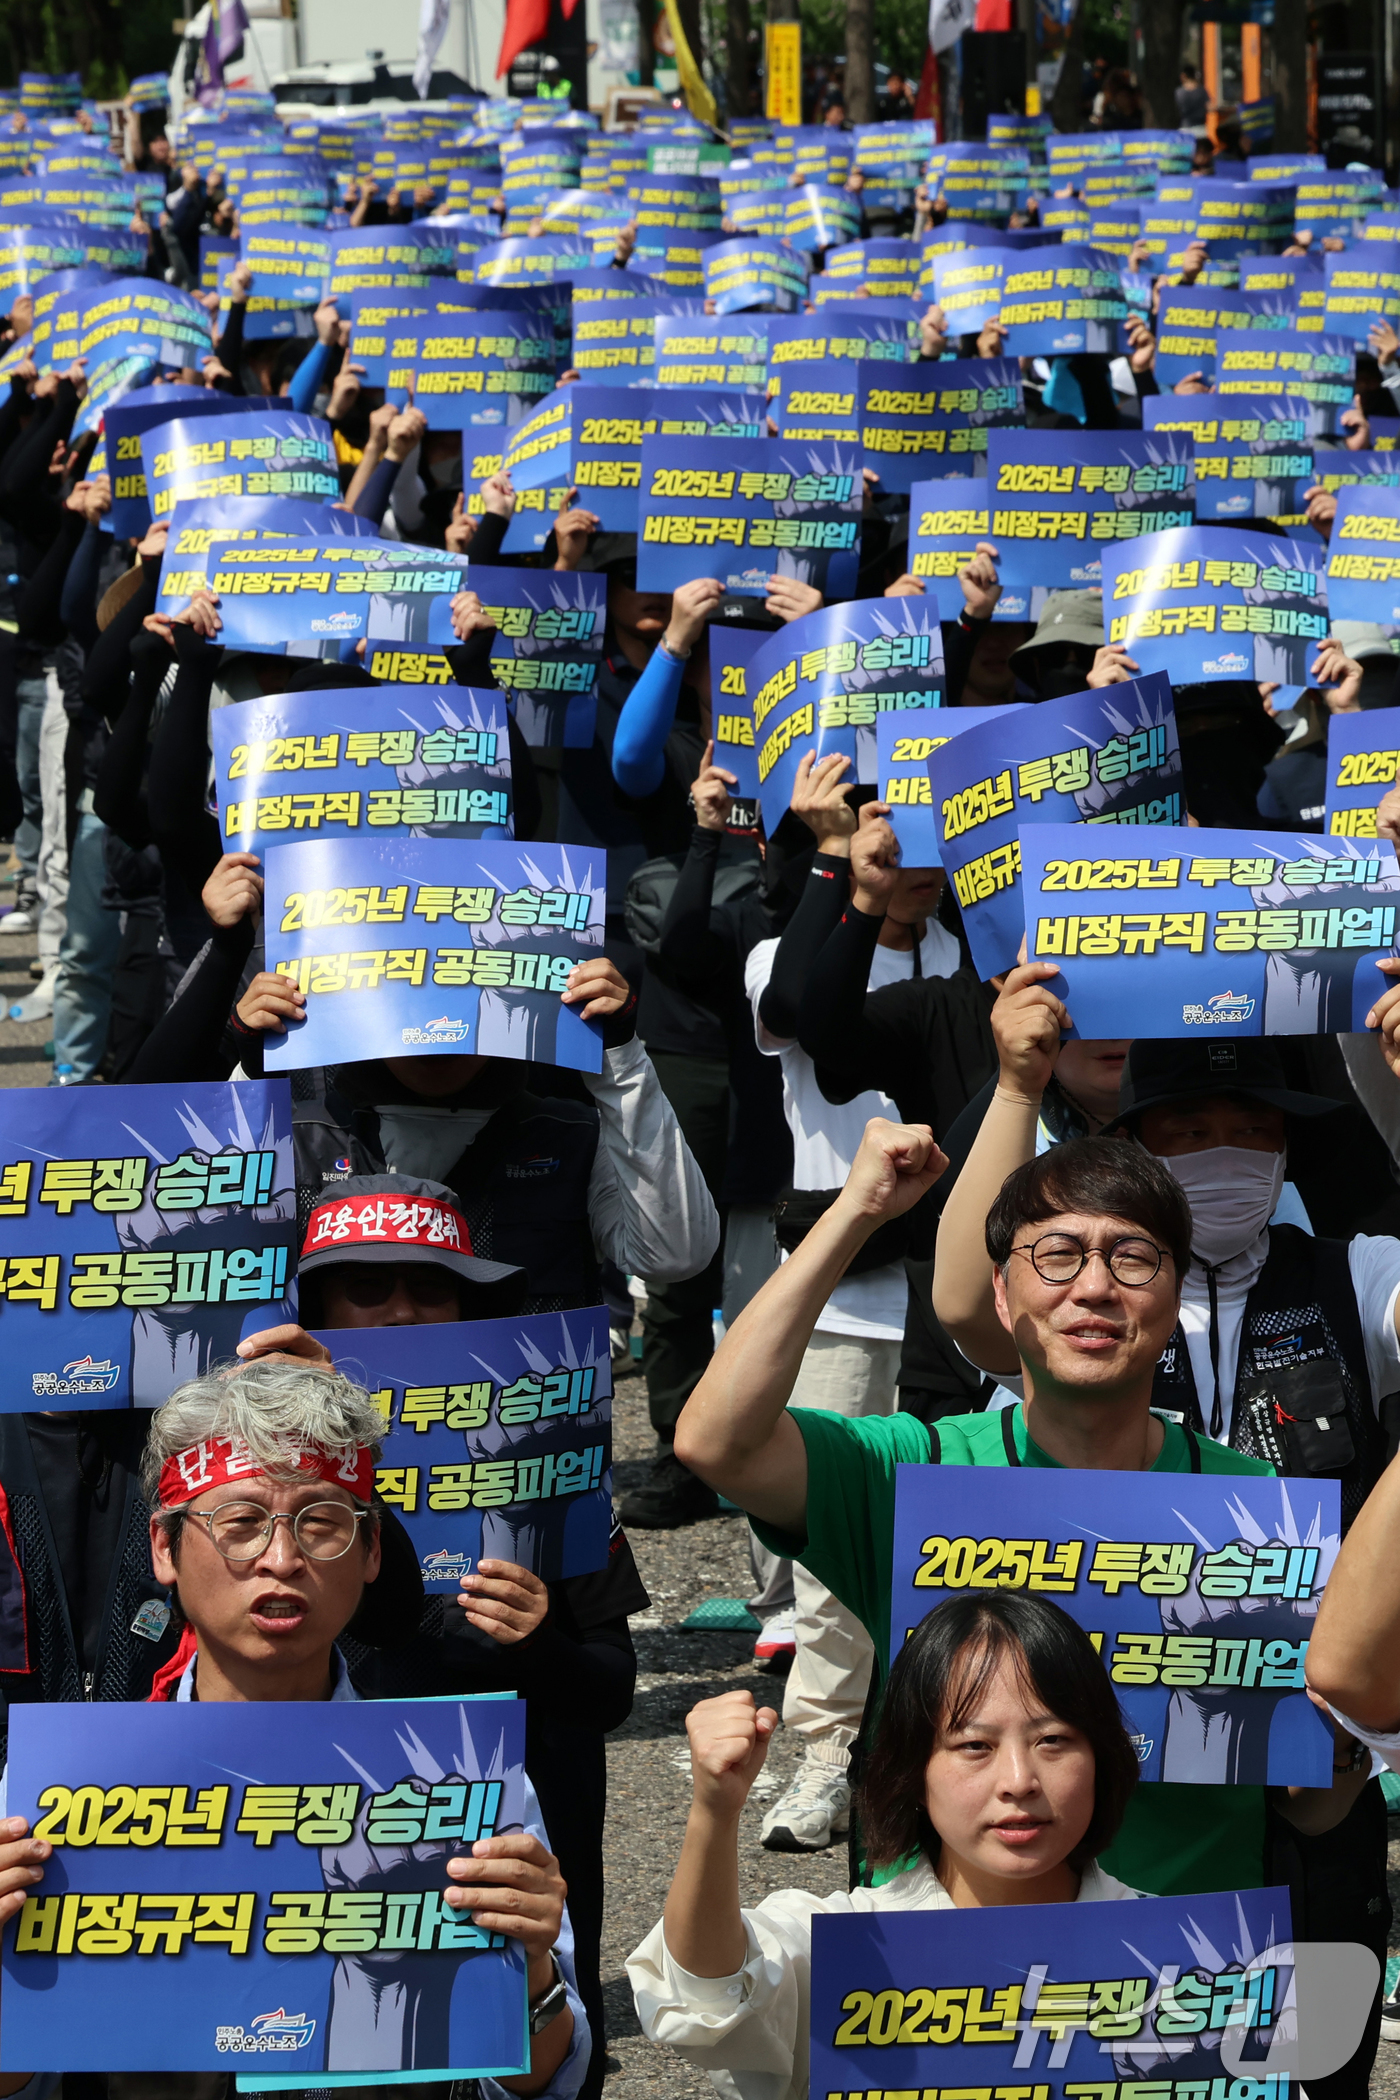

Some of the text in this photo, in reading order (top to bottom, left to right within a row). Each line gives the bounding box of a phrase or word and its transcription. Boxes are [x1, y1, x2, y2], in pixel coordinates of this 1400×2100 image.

[786, 391, 856, 416] 2025년
[866, 388, 936, 415] 2025년
[938, 388, 979, 413] 투쟁
[229, 436, 278, 462] 투쟁
[280, 435, 330, 463] 승리!
[861, 426, 947, 454] 비정규직
[246, 471, 340, 498] 공동파업!
[573, 460, 642, 488] 비정규
[650, 468, 854, 502] 2025년 투쟁 승리!
[996, 463, 1188, 493] 2025년 투쟁 승리!
[643, 515, 858, 550] 비정규직 공동파업!
[917, 509, 990, 537] 2025년
[992, 510, 1088, 540] 비정규직
[911, 551, 978, 577] 비정규
[1112, 560, 1200, 601] 2025년
[1203, 560, 1259, 588] 투쟁
[1261, 564, 1317, 597] 승리!
[212, 571, 463, 595] 비정규직 공동파업!
[533, 606, 597, 641] 승리!
[1109, 604, 1328, 643] 비정규직 공동파업!
[370, 651, 457, 686] 비정규
[752, 659, 797, 733] 2025년
[800, 639, 857, 683] 투쟁
[861, 634, 930, 671] 승리!
[226, 728, 498, 781] 2025년 투쟁 승리!
[757, 702, 814, 784] 비정규직
[941, 723, 1167, 842] 2025년 투쟁 승리!
[1335, 749, 1400, 788] 2025
[225, 788, 508, 838] 비정규직 공동파업!
[1329, 807, 1379, 839] 비정
[1040, 857, 1382, 892] 2025년 투쟁 승리!
[279, 885, 592, 934] 2025년 투쟁 승리!
[1034, 905, 1397, 956] 비정규직 공동파업!
[275, 948, 588, 996] 비정규직 공동파업
[1182, 1010, 1243, 1024] 공공운수노조
[401, 1032, 459, 1044] 공공운수노조
[38, 1155, 147, 1215] 투쟁
[154, 1150, 274, 1211] 승리!
[69, 1246, 289, 1308] 공동파업!
[31, 1380, 105, 1396] 공공운수노조
[400, 1380, 493, 1432] 투쟁
[499, 1367, 596, 1425] 승리!
[427, 1444, 605, 1511] 공동파업!
[913, 1536, 1320, 1599] 2025년 투쟁 승리!
[1112, 1633, 1308, 1688] 공동파업
[32, 1780, 504, 1847] 2025년 투쟁 승리!
[14, 1892, 256, 1955] 비정규직
[833, 1965, 1278, 2047] 2025년 투쟁 승리!
[214, 2034, 299, 2053] 공공운수노조
